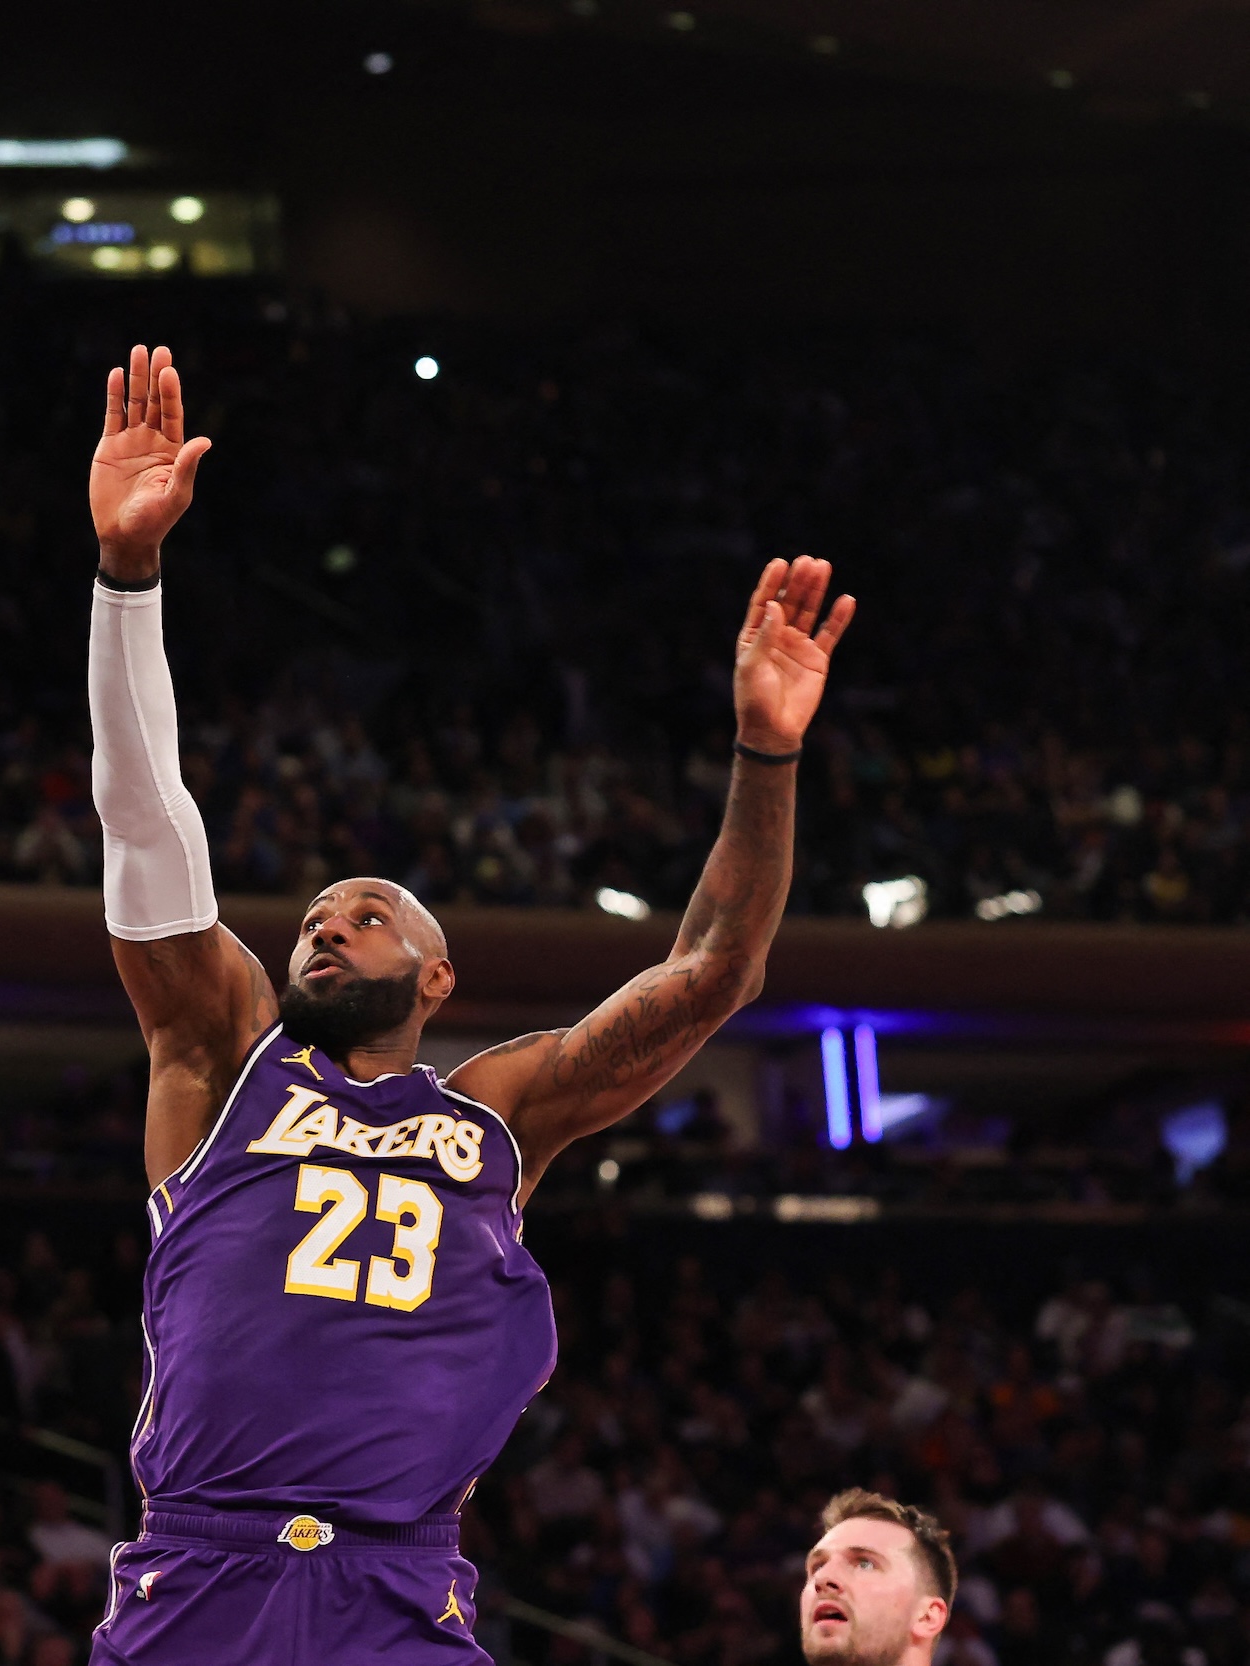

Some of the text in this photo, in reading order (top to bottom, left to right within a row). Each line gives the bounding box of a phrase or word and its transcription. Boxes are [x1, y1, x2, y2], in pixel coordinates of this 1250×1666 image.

[246, 1084, 485, 1183] LAKERS
[284, 1163, 445, 1313] 23
[278, 1523, 333, 1544] LAKERS
